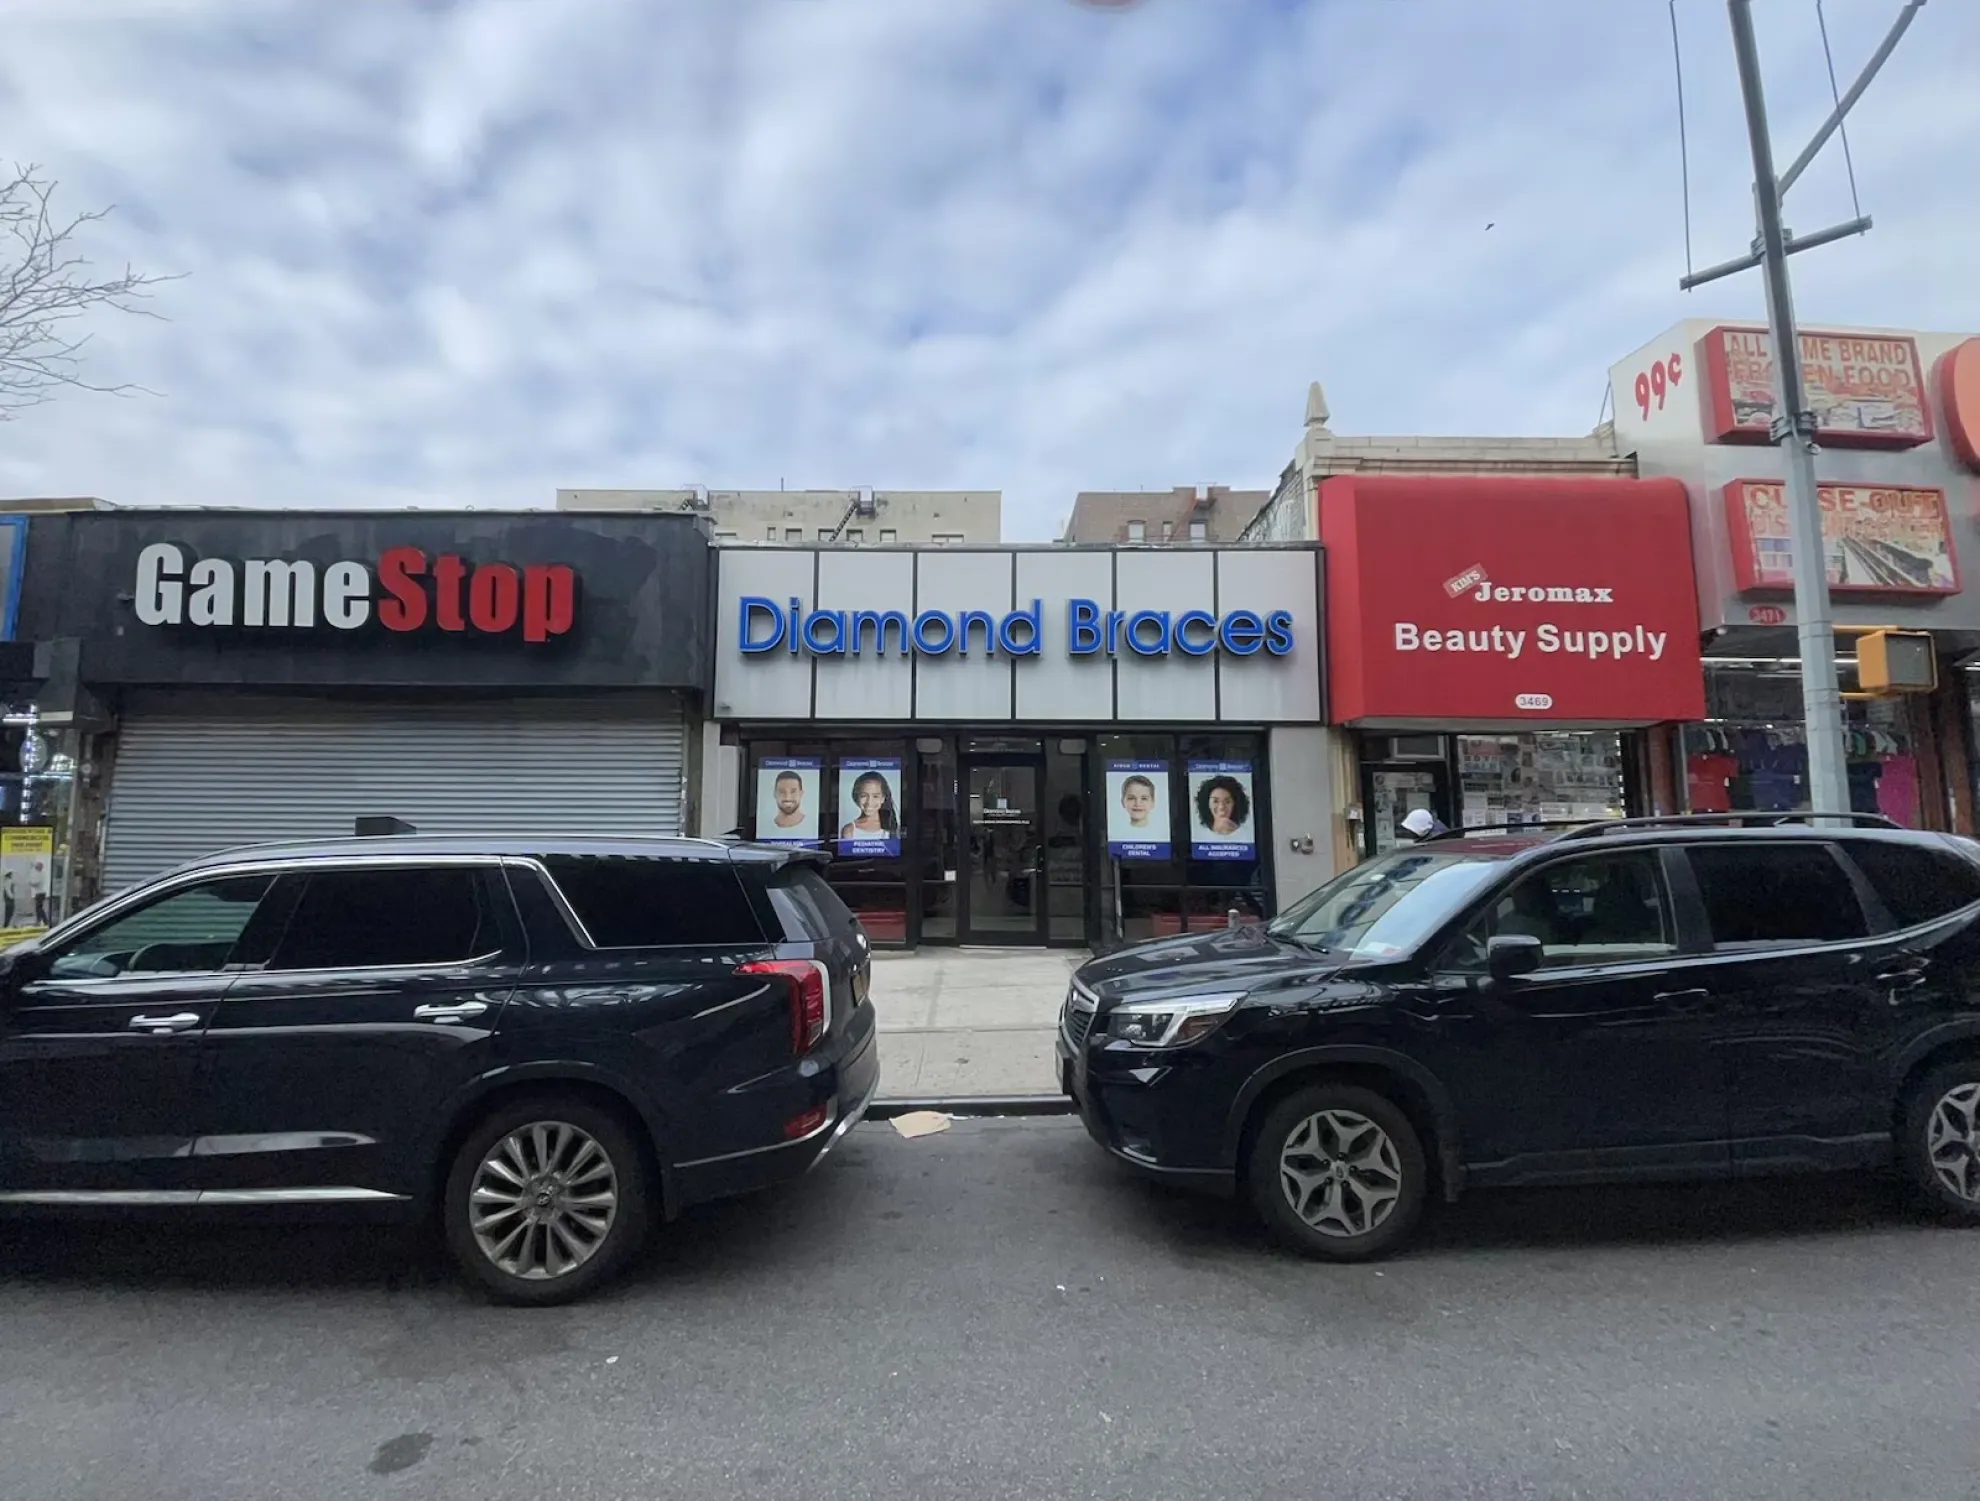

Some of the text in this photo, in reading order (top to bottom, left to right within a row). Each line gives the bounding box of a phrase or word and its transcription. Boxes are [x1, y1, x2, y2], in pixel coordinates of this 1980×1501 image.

[1729, 334, 1767, 357] ALL
[1838, 340, 1908, 365] BRAND
[135, 542, 576, 643] GameStop
[1474, 581, 1614, 604] Jeromax
[739, 596, 1295, 657] Diamond Braces
[1394, 623, 1667, 661] Beauty Supply
[1519, 696, 1549, 707] 3469
